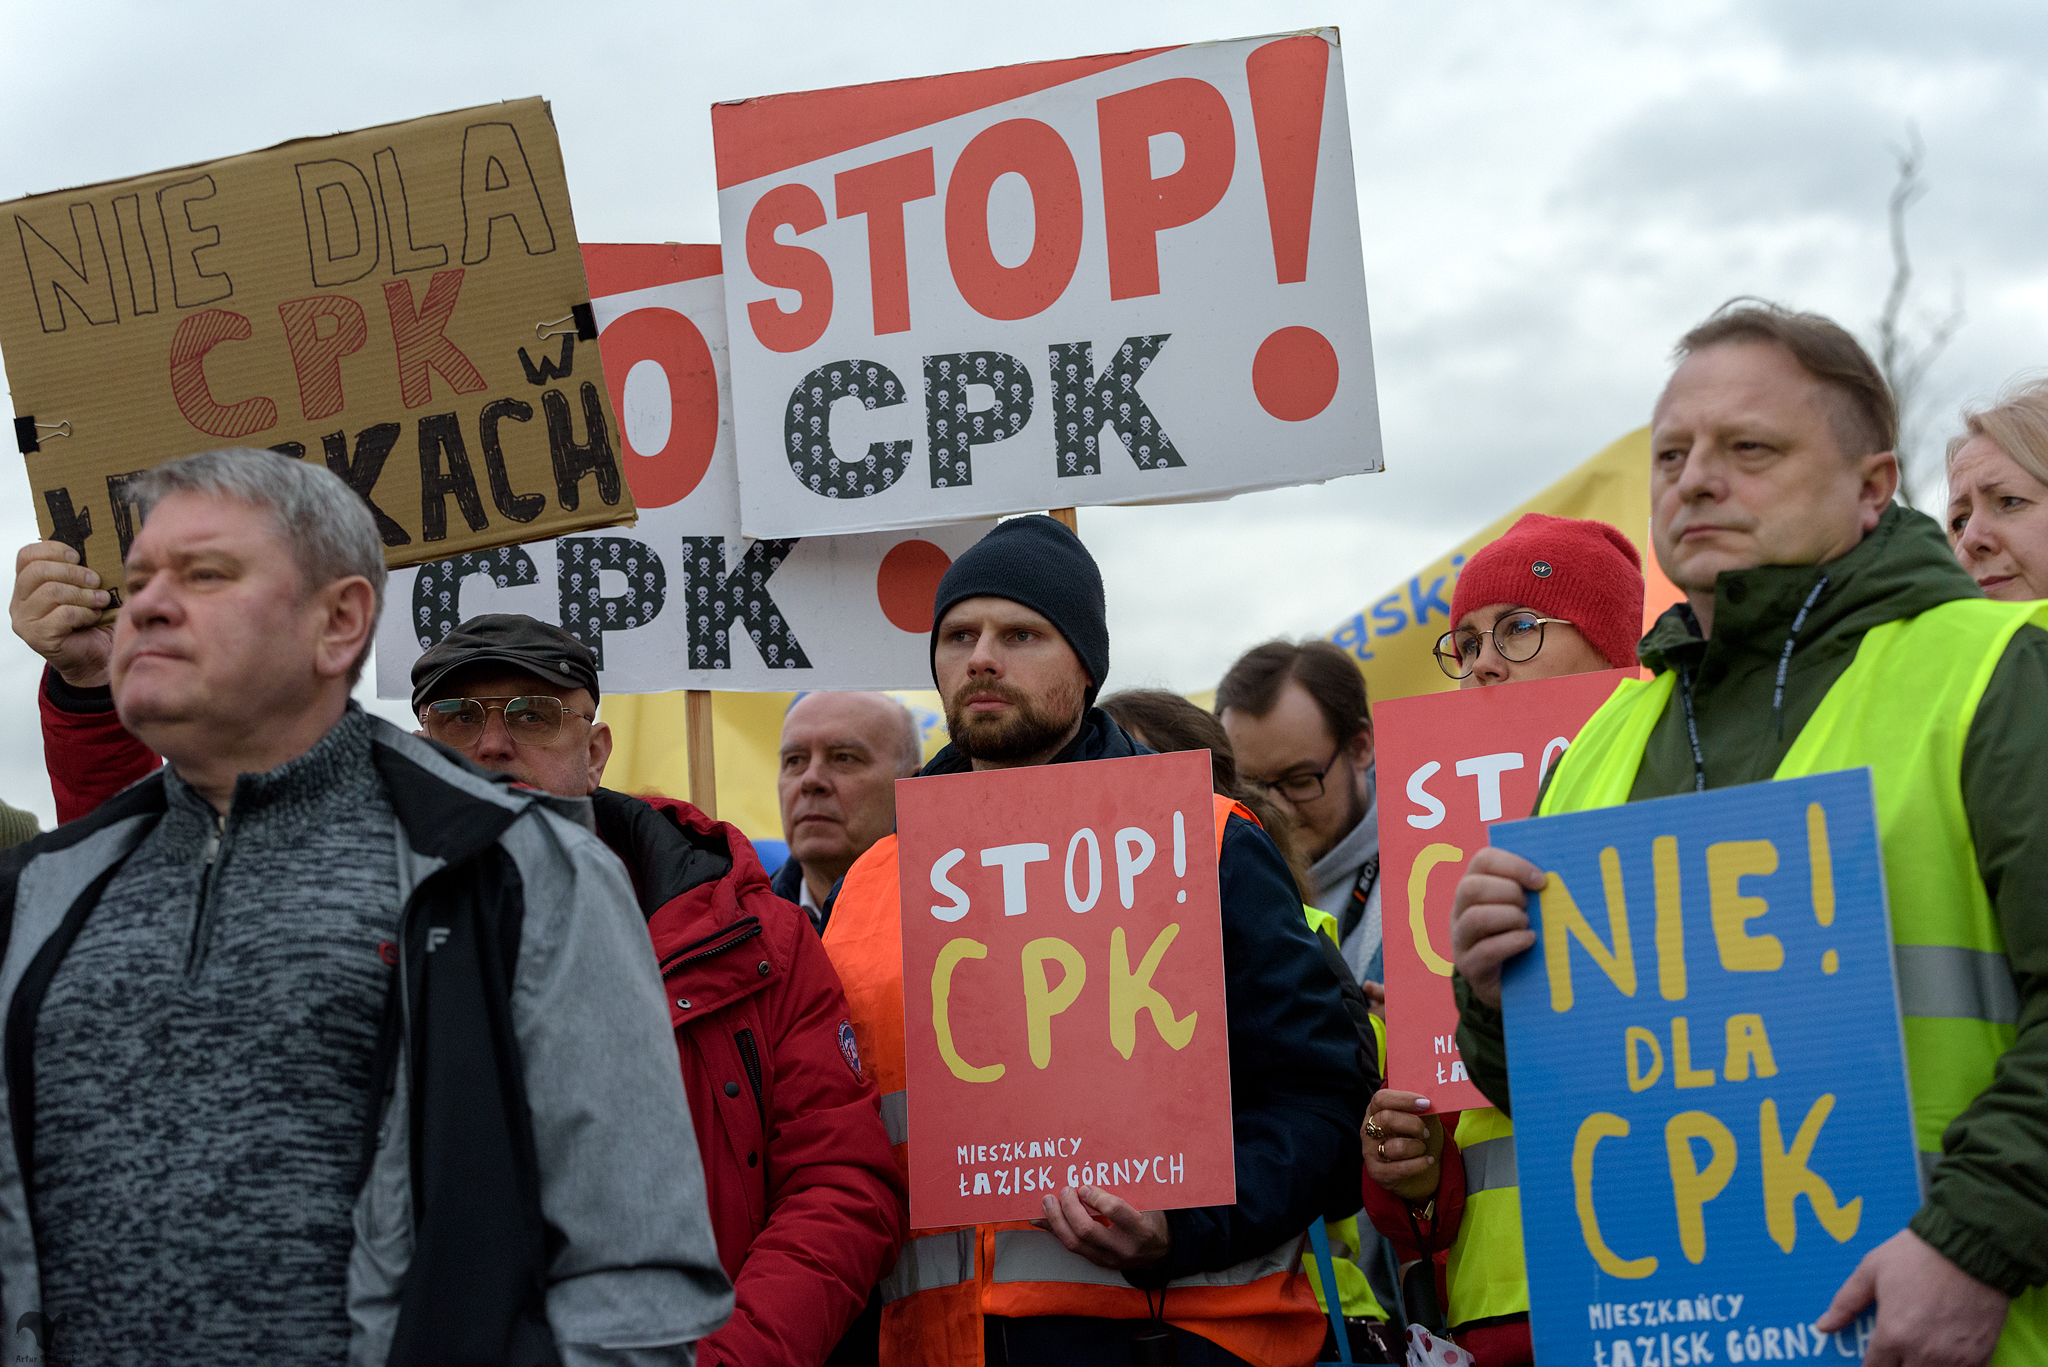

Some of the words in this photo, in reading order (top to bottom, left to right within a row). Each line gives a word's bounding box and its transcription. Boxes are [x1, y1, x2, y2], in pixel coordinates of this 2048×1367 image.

[14, 174, 233, 333] NIE
[295, 122, 557, 288] DLA
[745, 36, 1340, 422] STOP!
[170, 269, 488, 437] CPK
[784, 333, 1188, 499] CPK
[930, 811, 1187, 922] STOP!
[1539, 803, 1839, 1012] NIE!
[931, 923, 1198, 1083] CPK
[1625, 1013, 1779, 1092] DLA
[957, 1137, 1082, 1166] MIESZKAŃCY
[958, 1165, 1056, 1197] ŁAZISK
[1067, 1152, 1185, 1188] GÓRNYCH
[1571, 1093, 1863, 1279] CPK
[1588, 1293, 1744, 1330] MIESZKAŃCY
[1594, 1330, 1715, 1367] ŁAZISK
